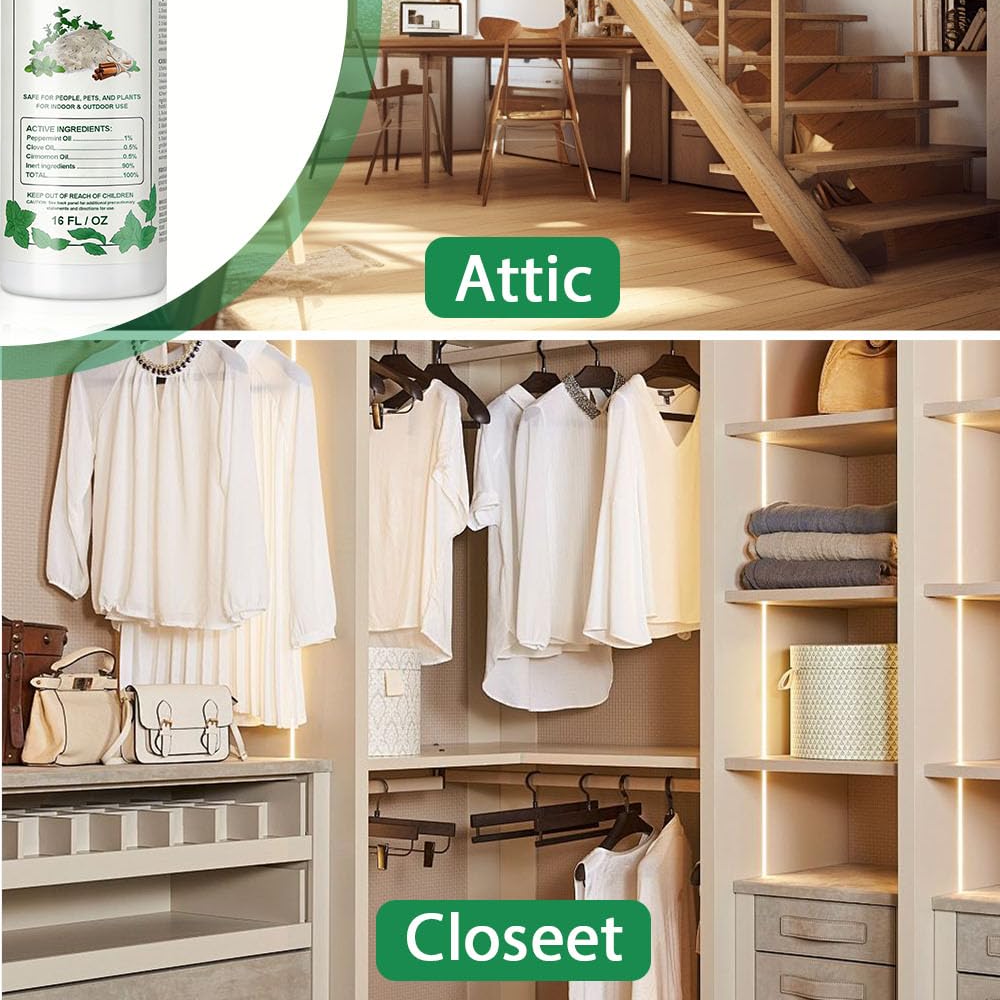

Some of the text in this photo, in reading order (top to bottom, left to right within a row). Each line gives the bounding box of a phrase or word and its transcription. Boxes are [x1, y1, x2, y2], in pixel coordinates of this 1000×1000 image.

[26, 125, 113, 133] ACTIVE INGREDIENTS:
[26, 135, 62, 143] Peppermint
[52, 216, 64, 226] 16
[67, 216, 82, 226] FL
[91, 216, 109, 226] OZ
